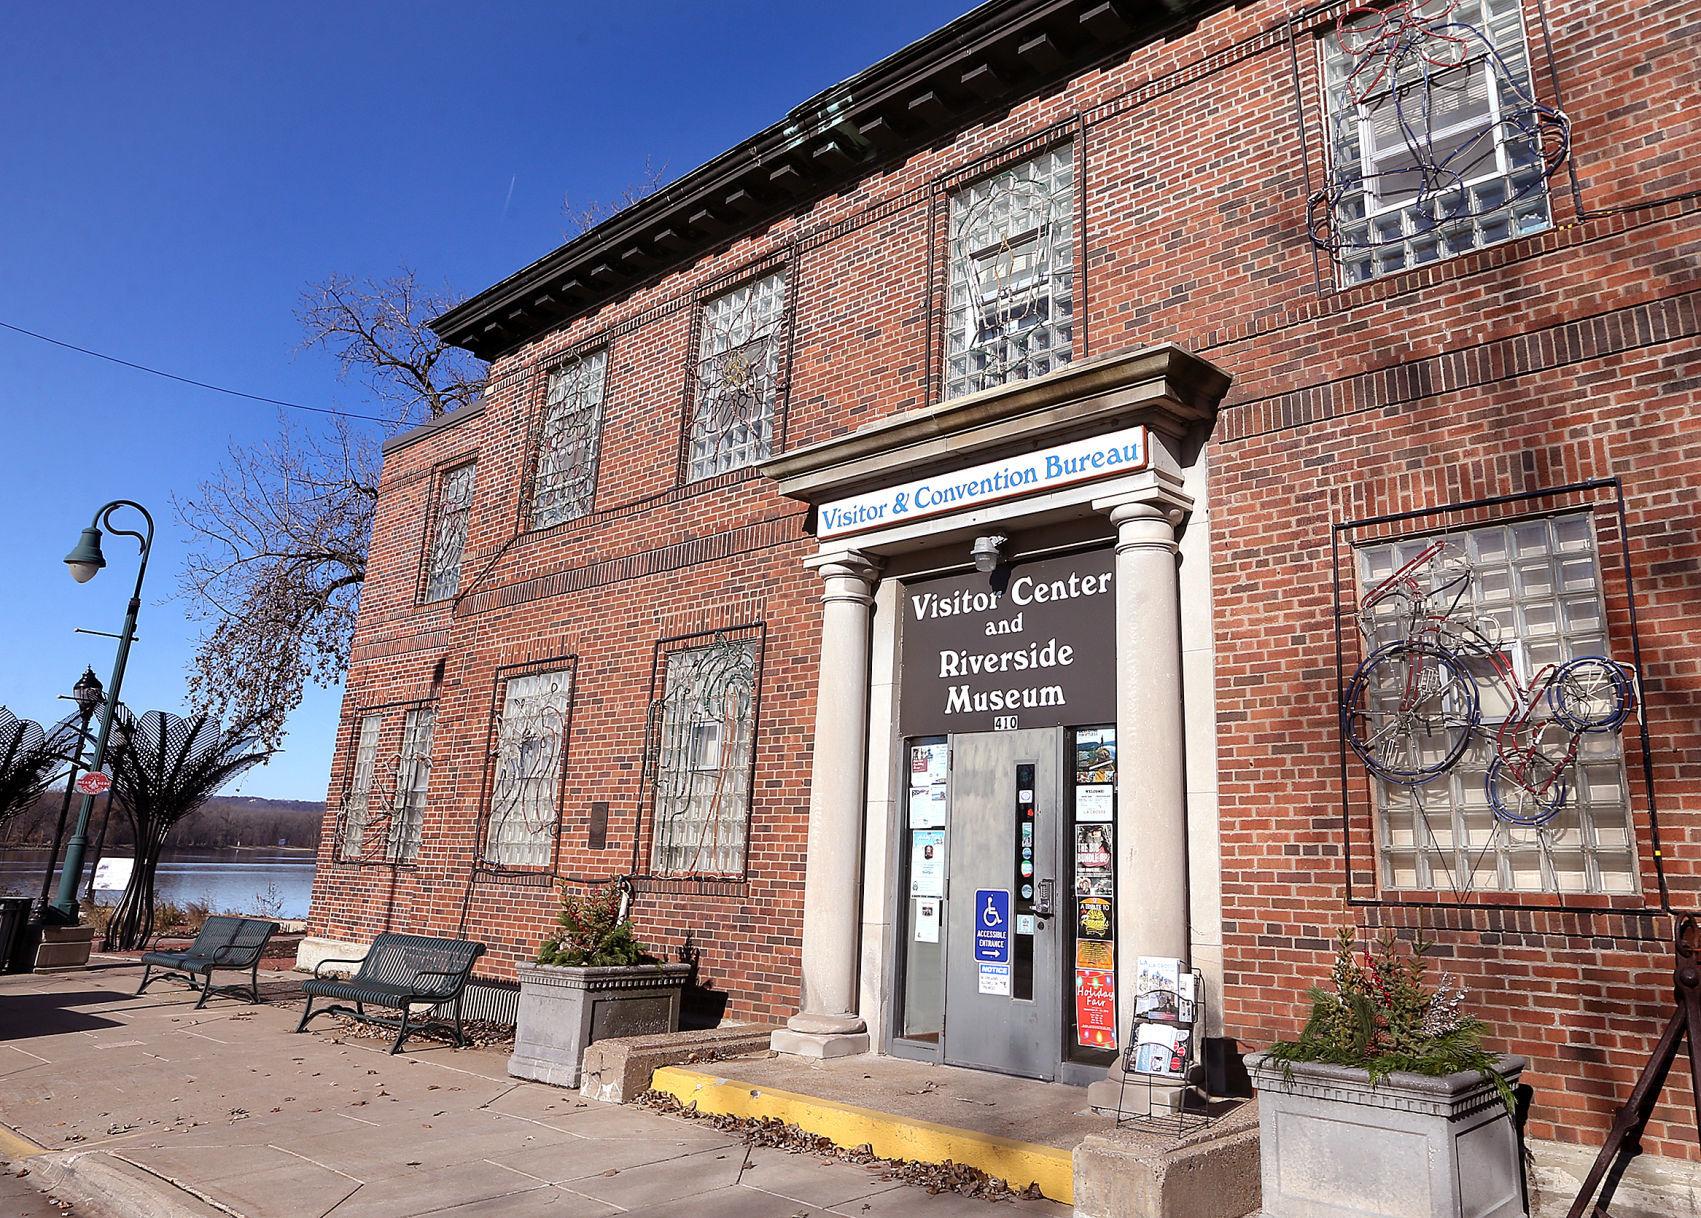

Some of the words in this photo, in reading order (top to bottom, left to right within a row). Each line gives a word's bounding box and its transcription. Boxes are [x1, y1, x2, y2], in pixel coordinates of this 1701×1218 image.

[822, 502, 888, 531] Visitor
[892, 491, 911, 515] &
[914, 466, 1039, 510] Convention
[1044, 441, 1140, 481] Bureau
[911, 587, 1002, 622] Visitor
[1011, 570, 1113, 607] Center
[984, 612, 1024, 636] and
[938, 637, 1075, 678] Riverside
[943, 683, 1067, 715] Museum
[995, 716, 1018, 730] 410
[977, 930, 1007, 940] ACCESSIBLE
[979, 939, 1005, 948] ENTRANCE
[981, 965, 1008, 975] NOTICE
[1077, 986, 1115, 1001] Holiday
[1086, 996, 1106, 1007] Fair
